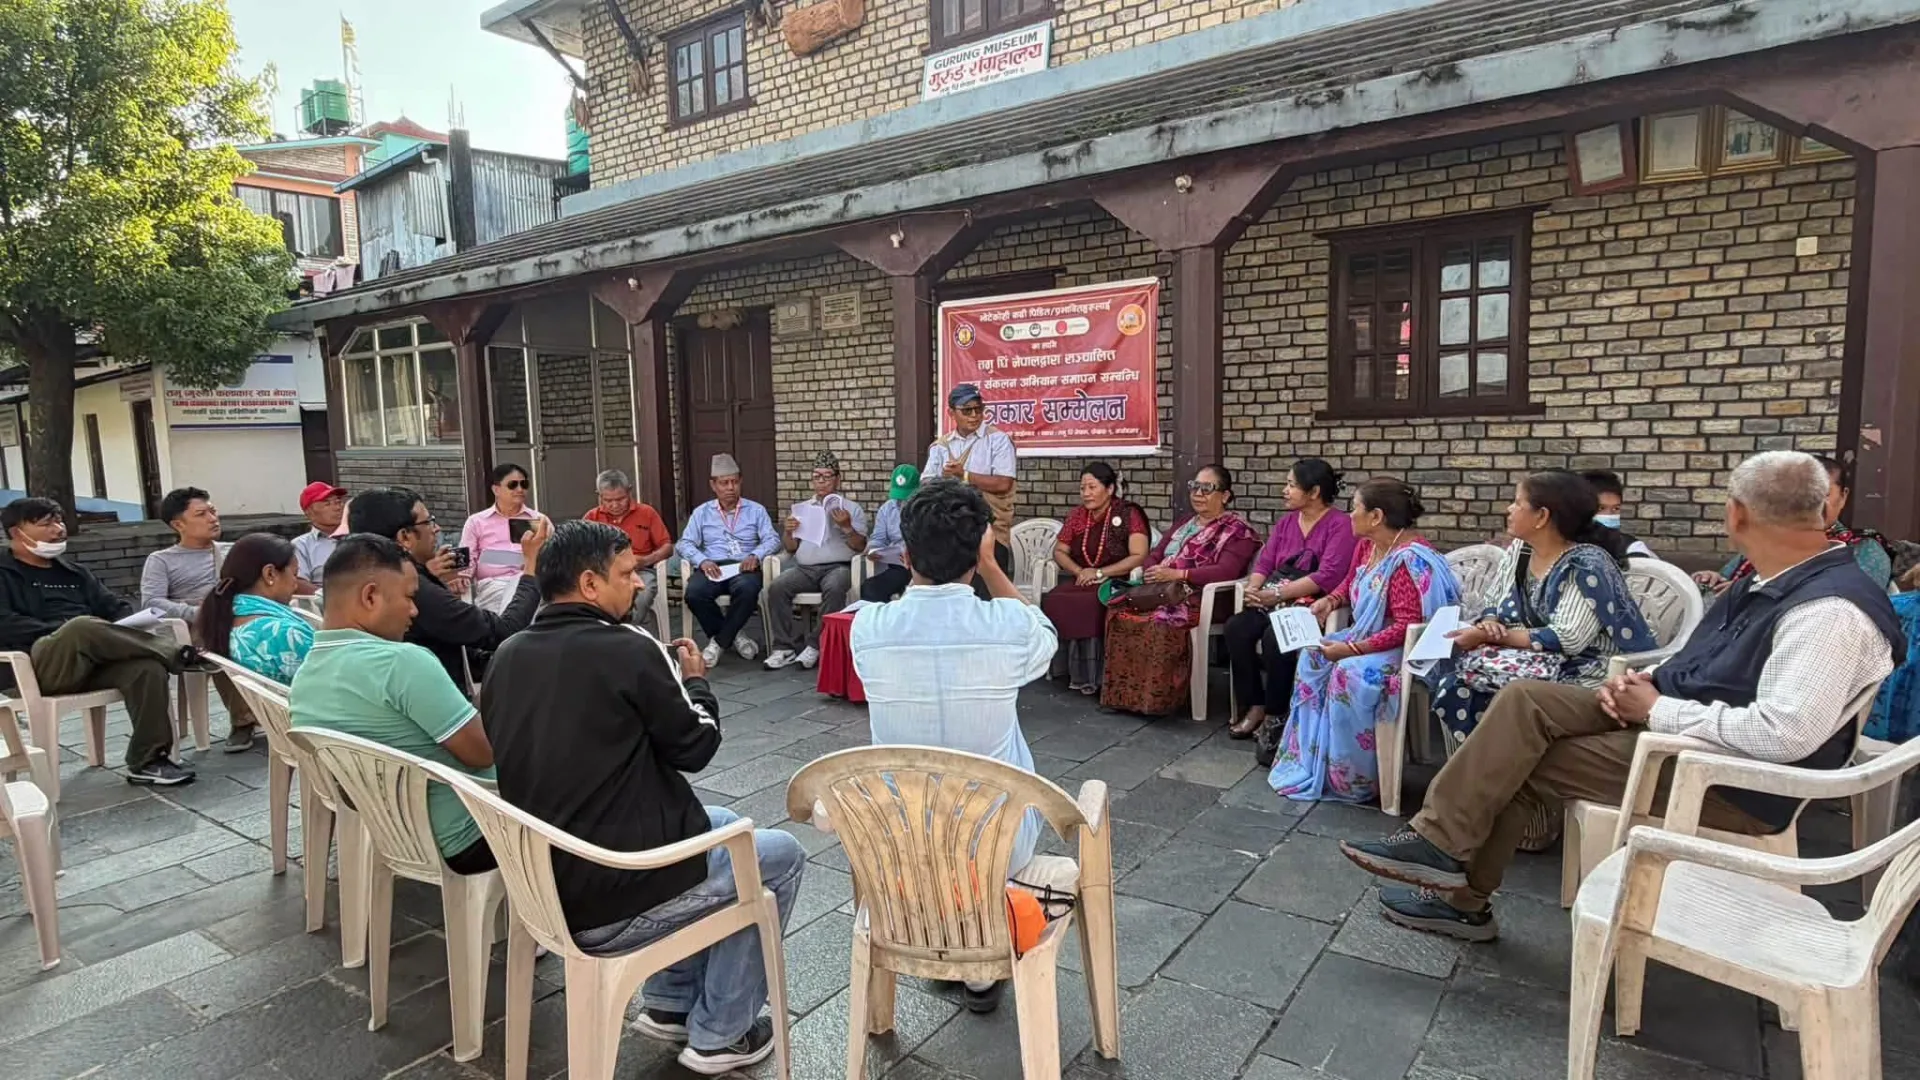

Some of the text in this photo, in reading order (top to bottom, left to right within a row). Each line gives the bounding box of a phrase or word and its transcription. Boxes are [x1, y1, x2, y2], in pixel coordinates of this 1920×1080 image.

[934, 31, 1038, 69] GURUNG MUSEUM
[969, 43, 1043, 76] संग्रहालय
[1012, 354, 1061, 369] नेपालद्वारा
[984, 377, 1017, 390] संकलन
[1020, 374, 1058, 387] अभियान
[1061, 373, 1097, 385] समापन
[983, 388, 1128, 425] त्रकार सम्मेलन
